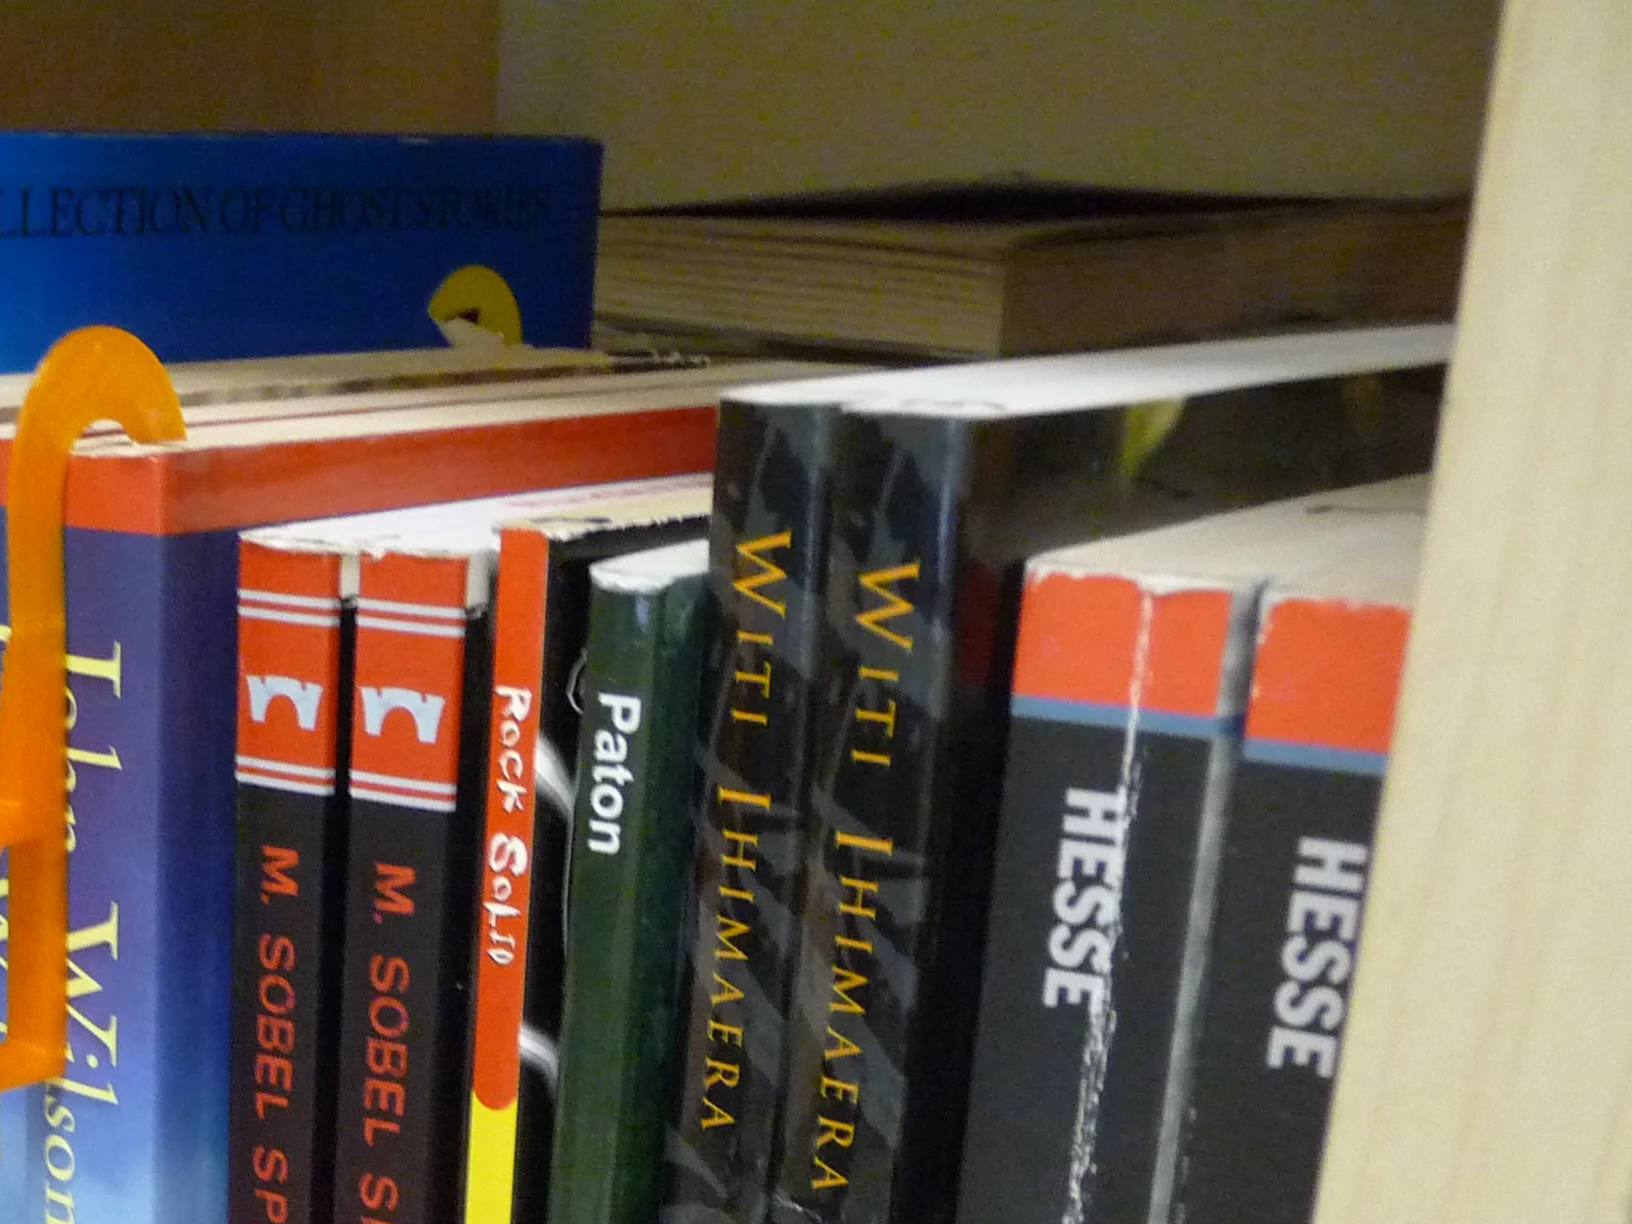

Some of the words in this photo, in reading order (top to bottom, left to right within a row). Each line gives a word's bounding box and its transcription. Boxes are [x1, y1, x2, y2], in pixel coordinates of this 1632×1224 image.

[219, 182, 279, 234] OF
[282, 182, 408, 232] GHOST
[411, 182, 549, 232] STORIES
[731, 529, 793, 727] WITI
[853, 562, 921, 768] WITI
[588, 691, 641, 855] Paton
[261, 843, 300, 905] M.
[372, 860, 416, 925] M.
[700, 785, 772, 1131] IHMAERA
[1043, 787, 1128, 1009] HESSE
[1267, 836, 1368, 1080] HESSE
[254, 933, 297, 1120] SOBEL
[364, 953, 411, 1148] SOBEL
[811, 830, 895, 1192] IHMAERA
